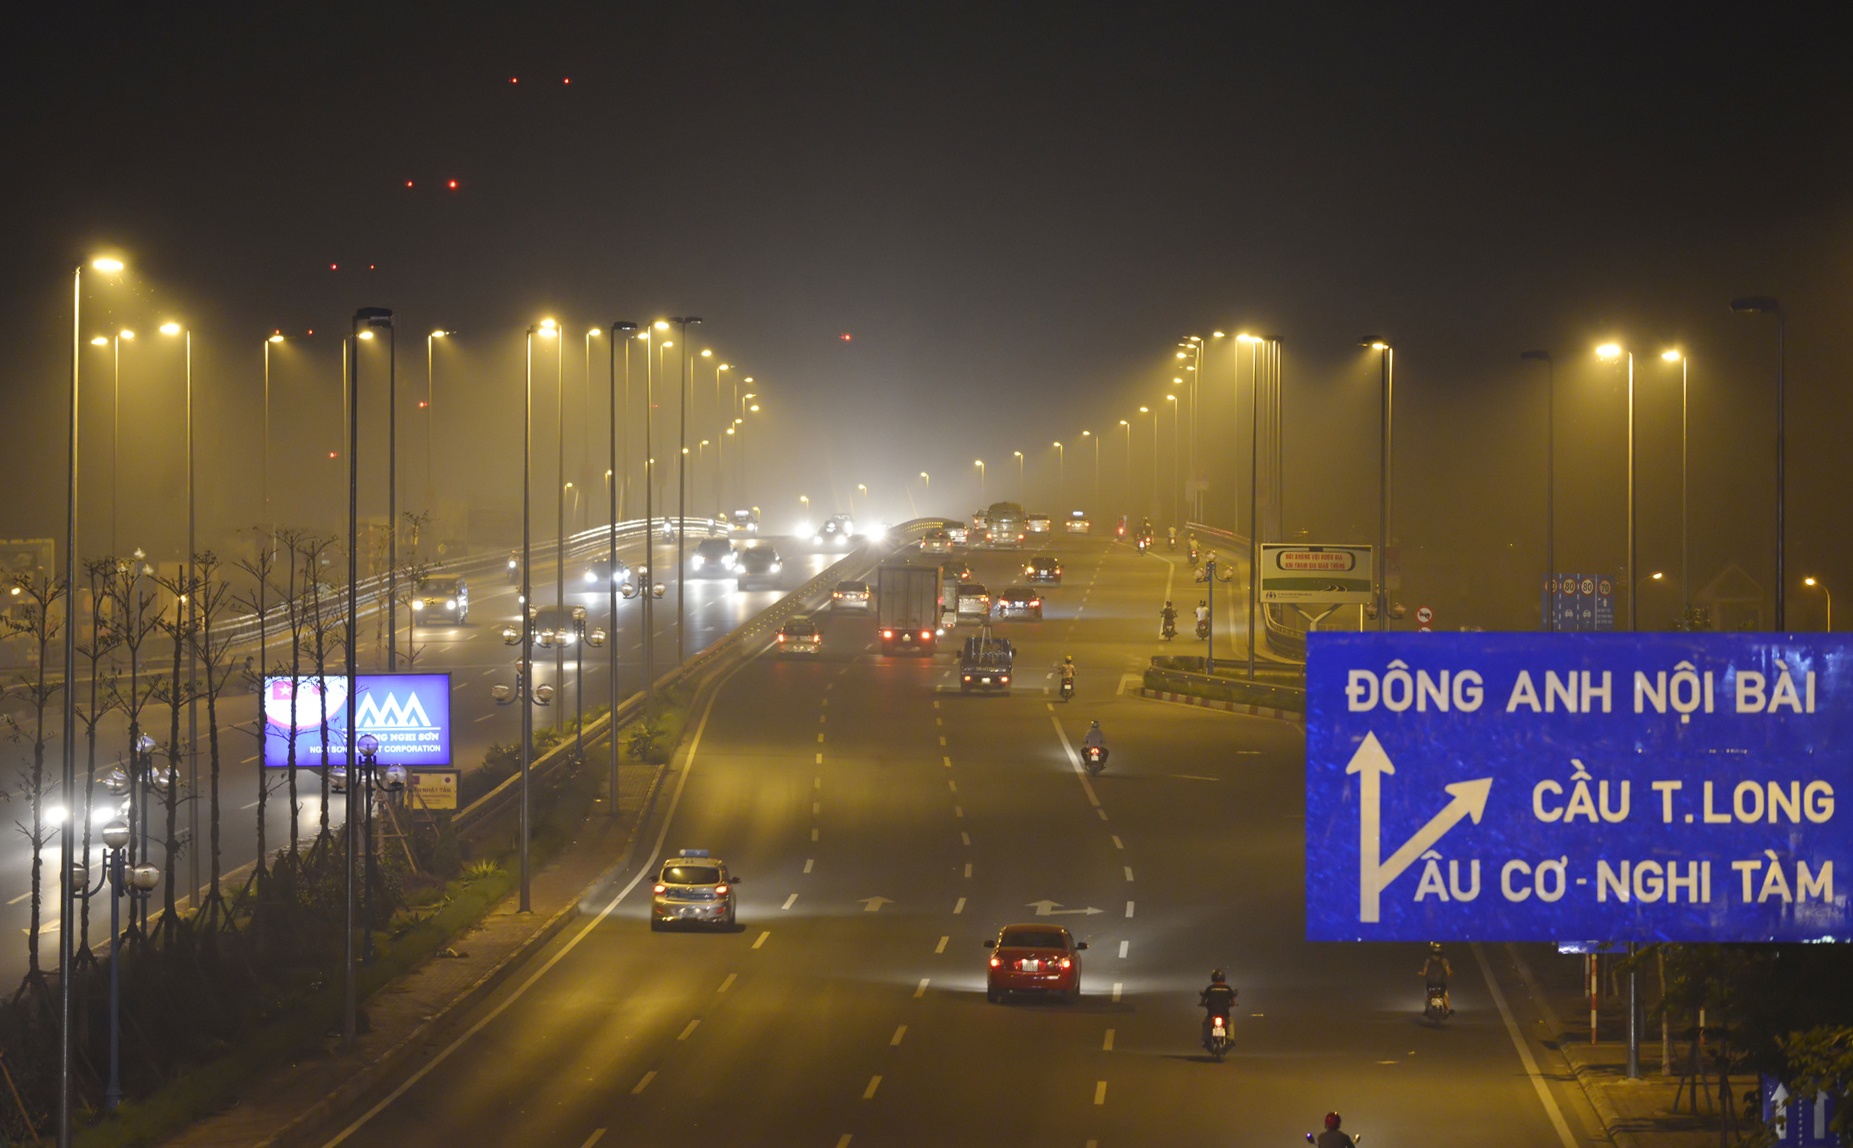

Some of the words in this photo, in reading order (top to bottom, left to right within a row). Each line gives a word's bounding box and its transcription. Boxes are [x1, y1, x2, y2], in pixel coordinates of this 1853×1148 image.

[1565, 582, 1574, 591] 80
[1583, 582, 1592, 591] 80
[1346, 659, 1483, 713] ĐÔNG
[1506, 670, 1612, 713] ANH
[1634, 661, 1714, 723] NỘI
[1736, 658, 1816, 714] BÀI
[390, 733, 416, 742] NGHI
[418, 732, 439, 742] SƠN
[384, 745, 441, 753] CORPORATION
[1533, 759, 1631, 823] CẦU
[1414, 850, 1481, 902] ÂU
[1732, 849, 1834, 903] TÀM
